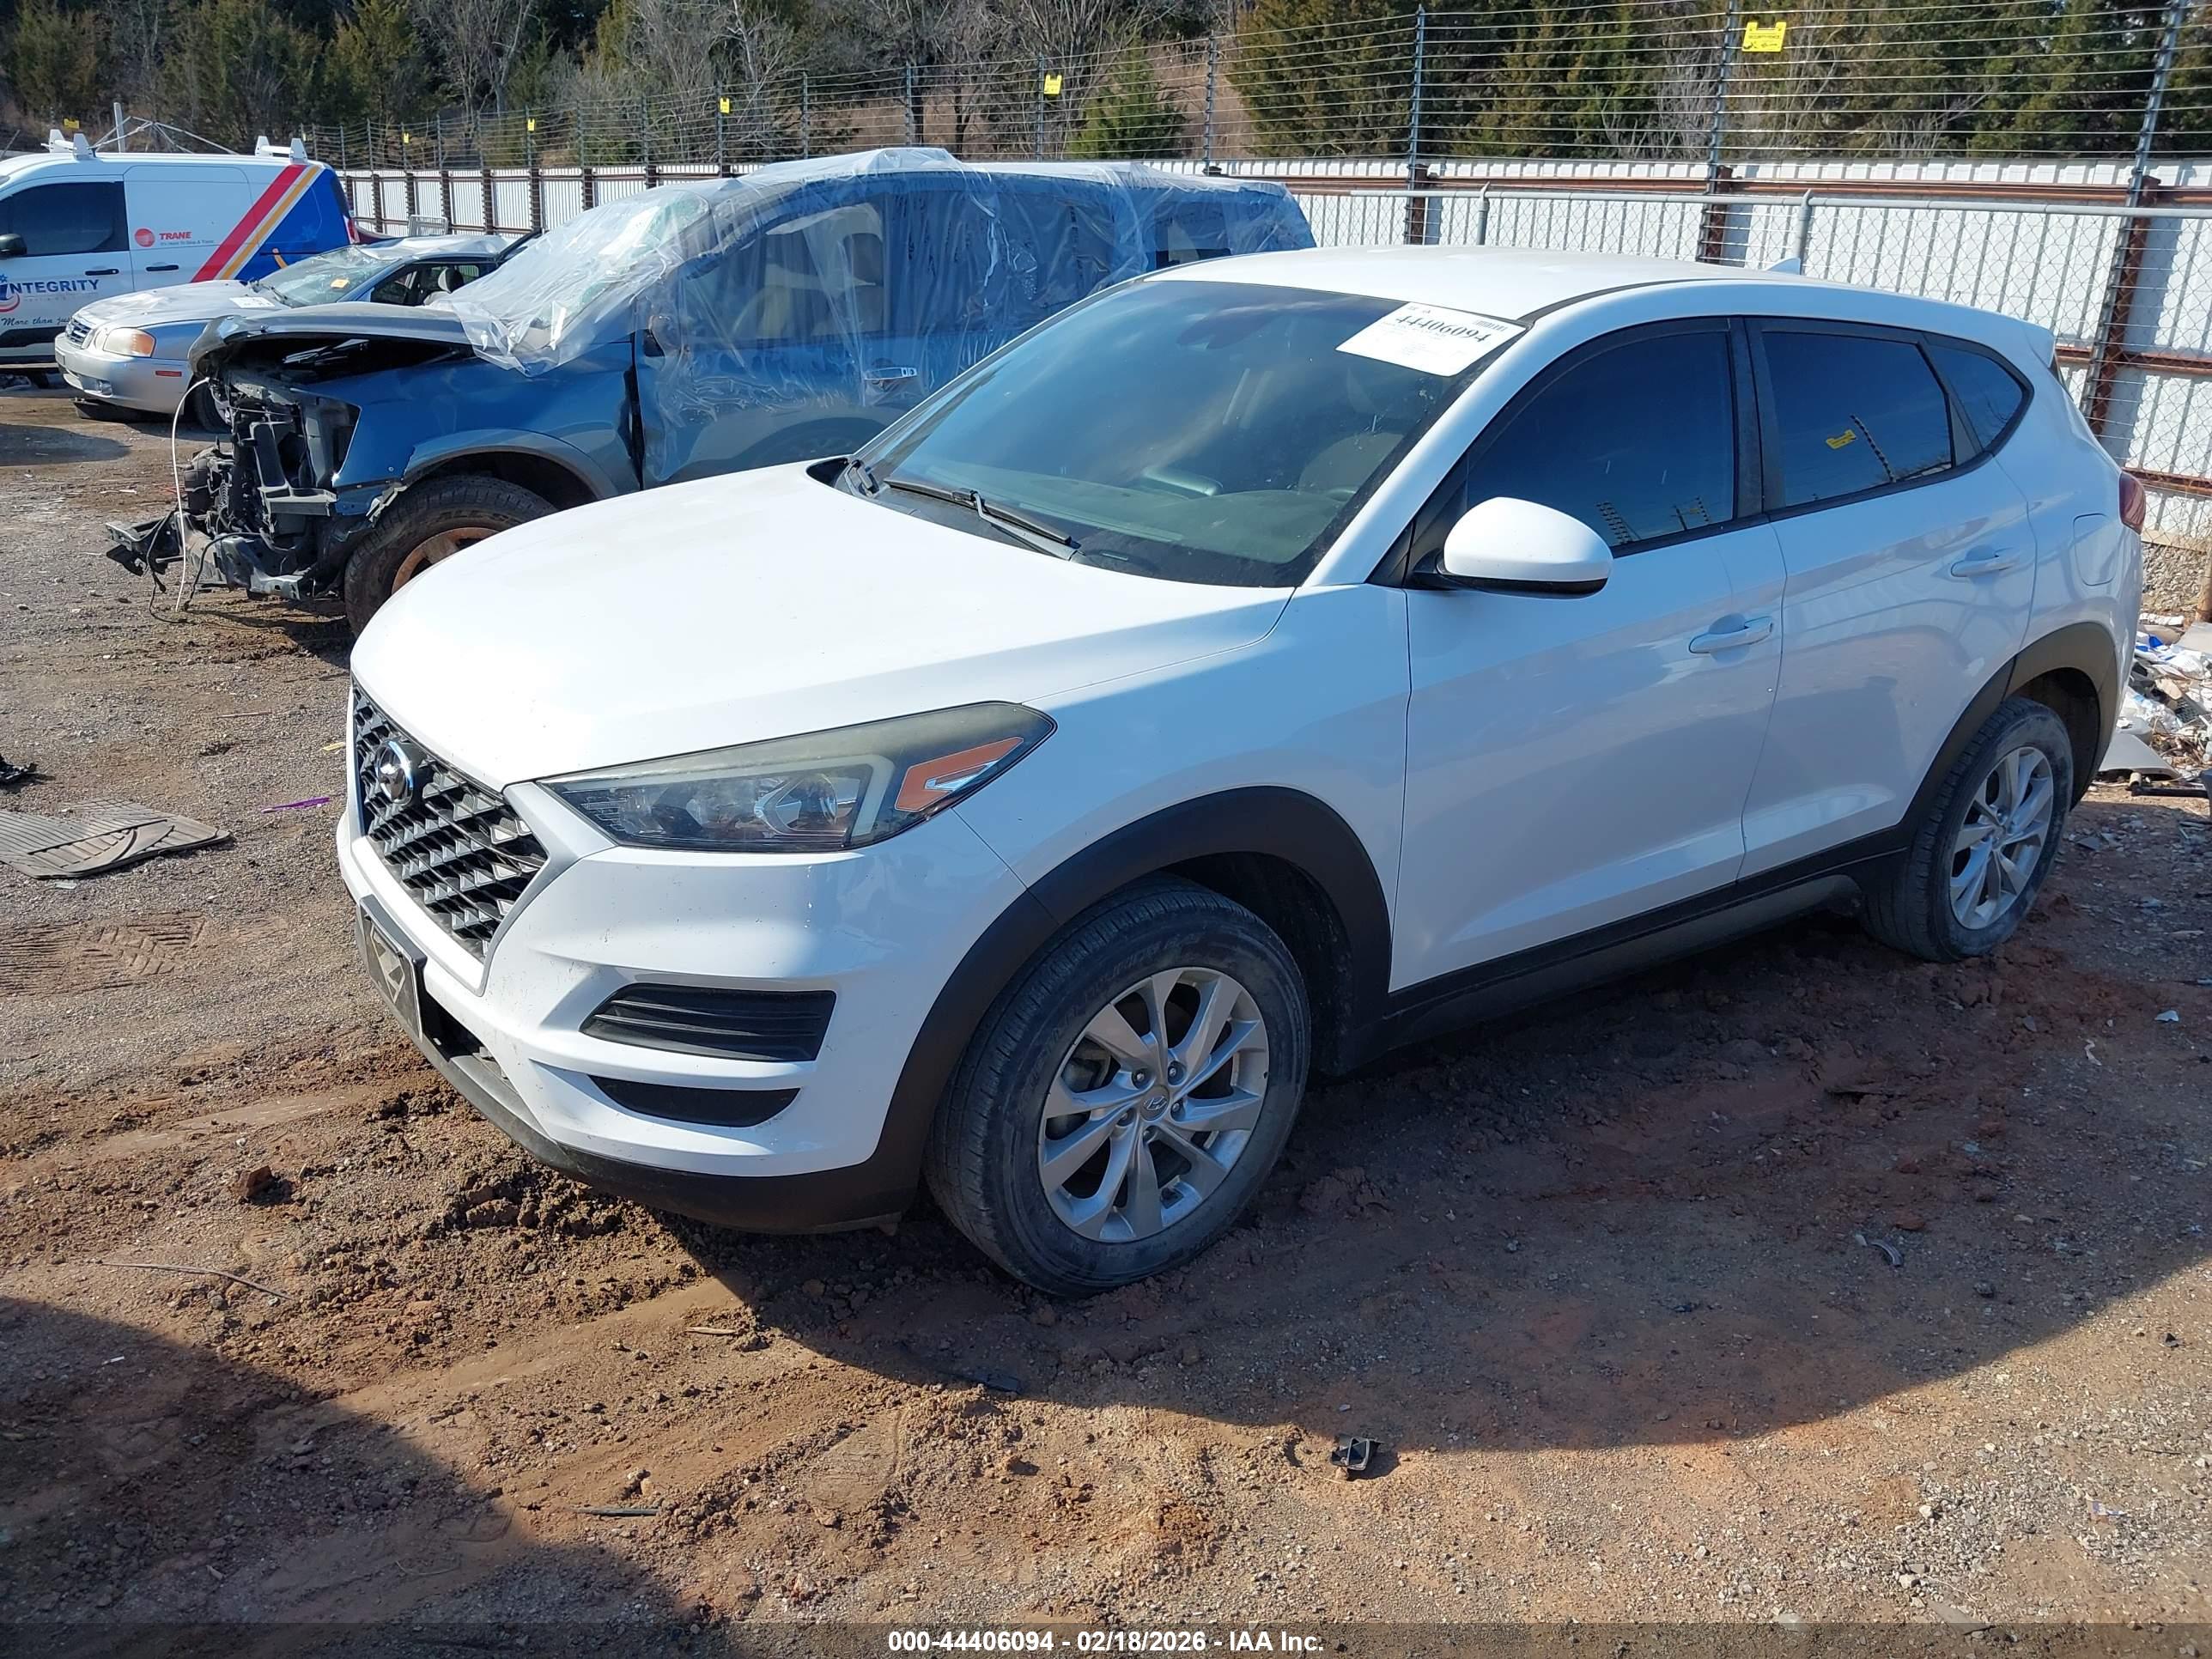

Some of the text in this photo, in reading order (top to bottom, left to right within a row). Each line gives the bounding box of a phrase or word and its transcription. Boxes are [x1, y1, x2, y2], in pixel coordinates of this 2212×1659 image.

[1, 317, 28, 325] More
[33, 316, 52, 325] than
[1395, 315, 1492, 343] 44406094
